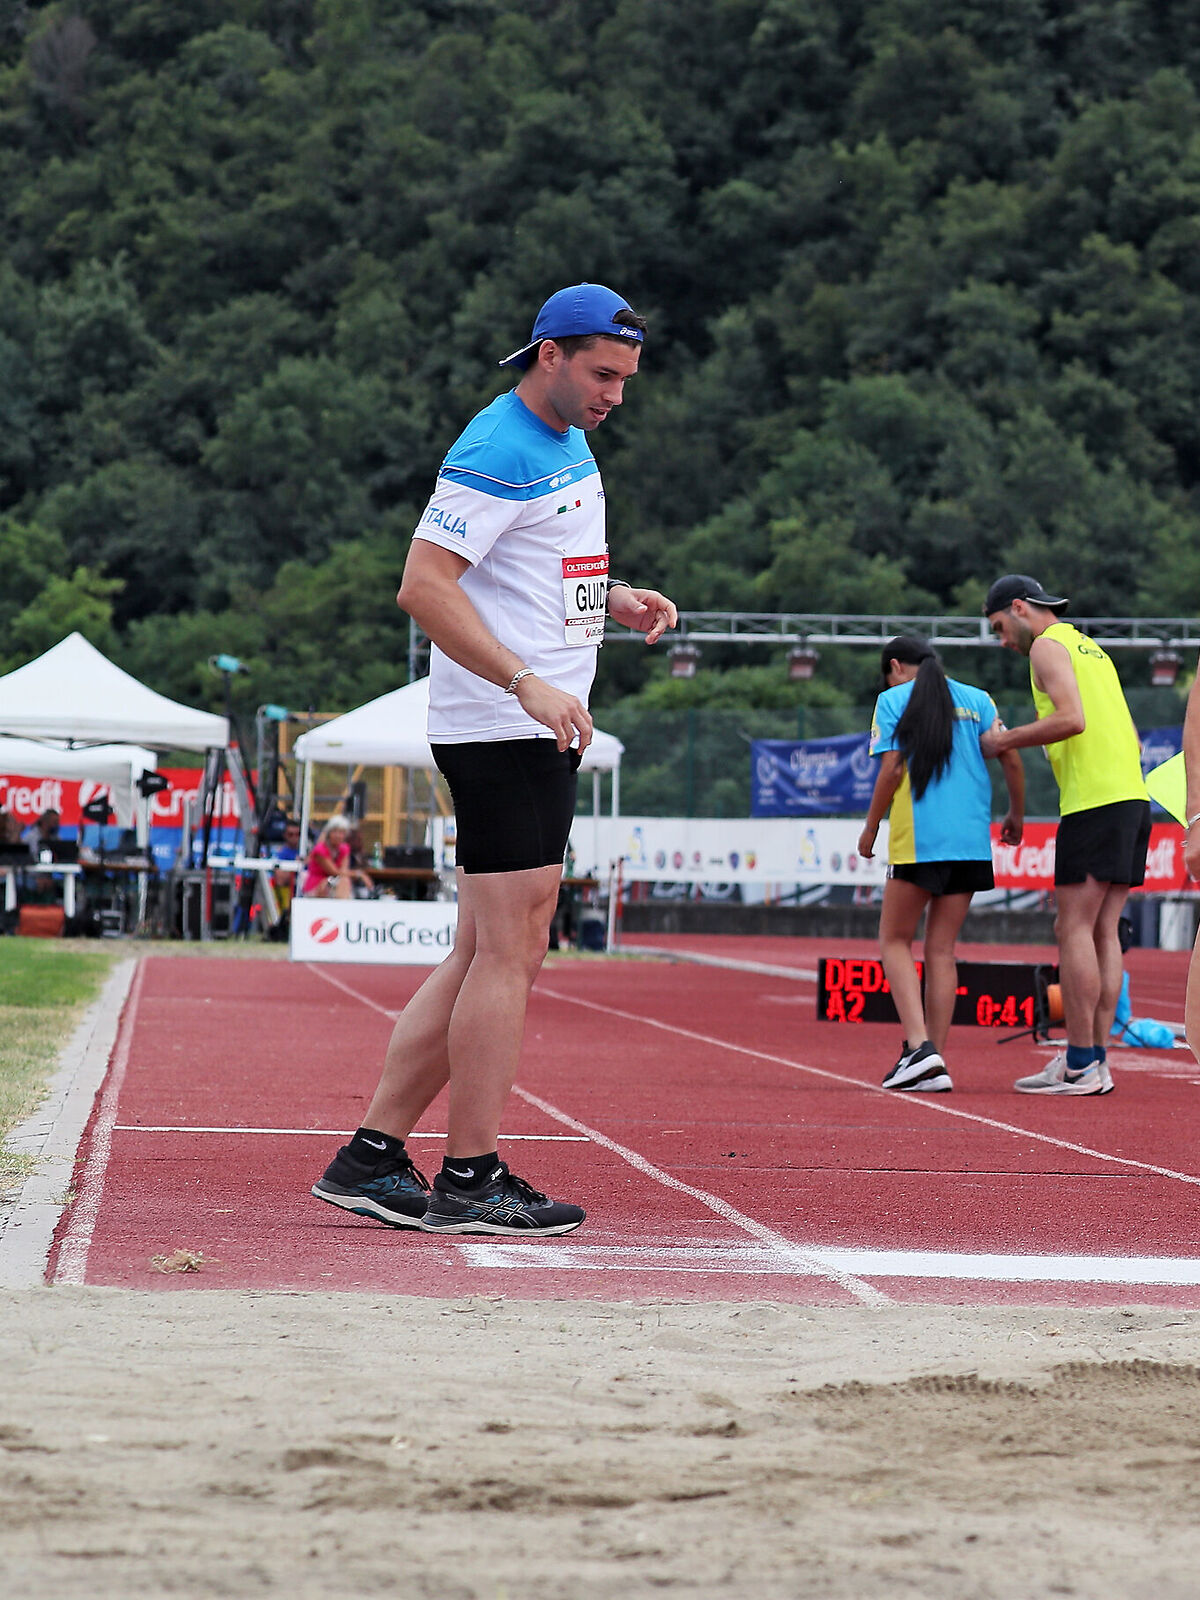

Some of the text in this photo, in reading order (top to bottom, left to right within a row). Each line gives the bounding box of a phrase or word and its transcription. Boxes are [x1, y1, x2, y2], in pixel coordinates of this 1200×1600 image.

[422, 507, 466, 538] ITALIA
[826, 991, 865, 1022] A2
[976, 995, 1034, 1027] 0:41
